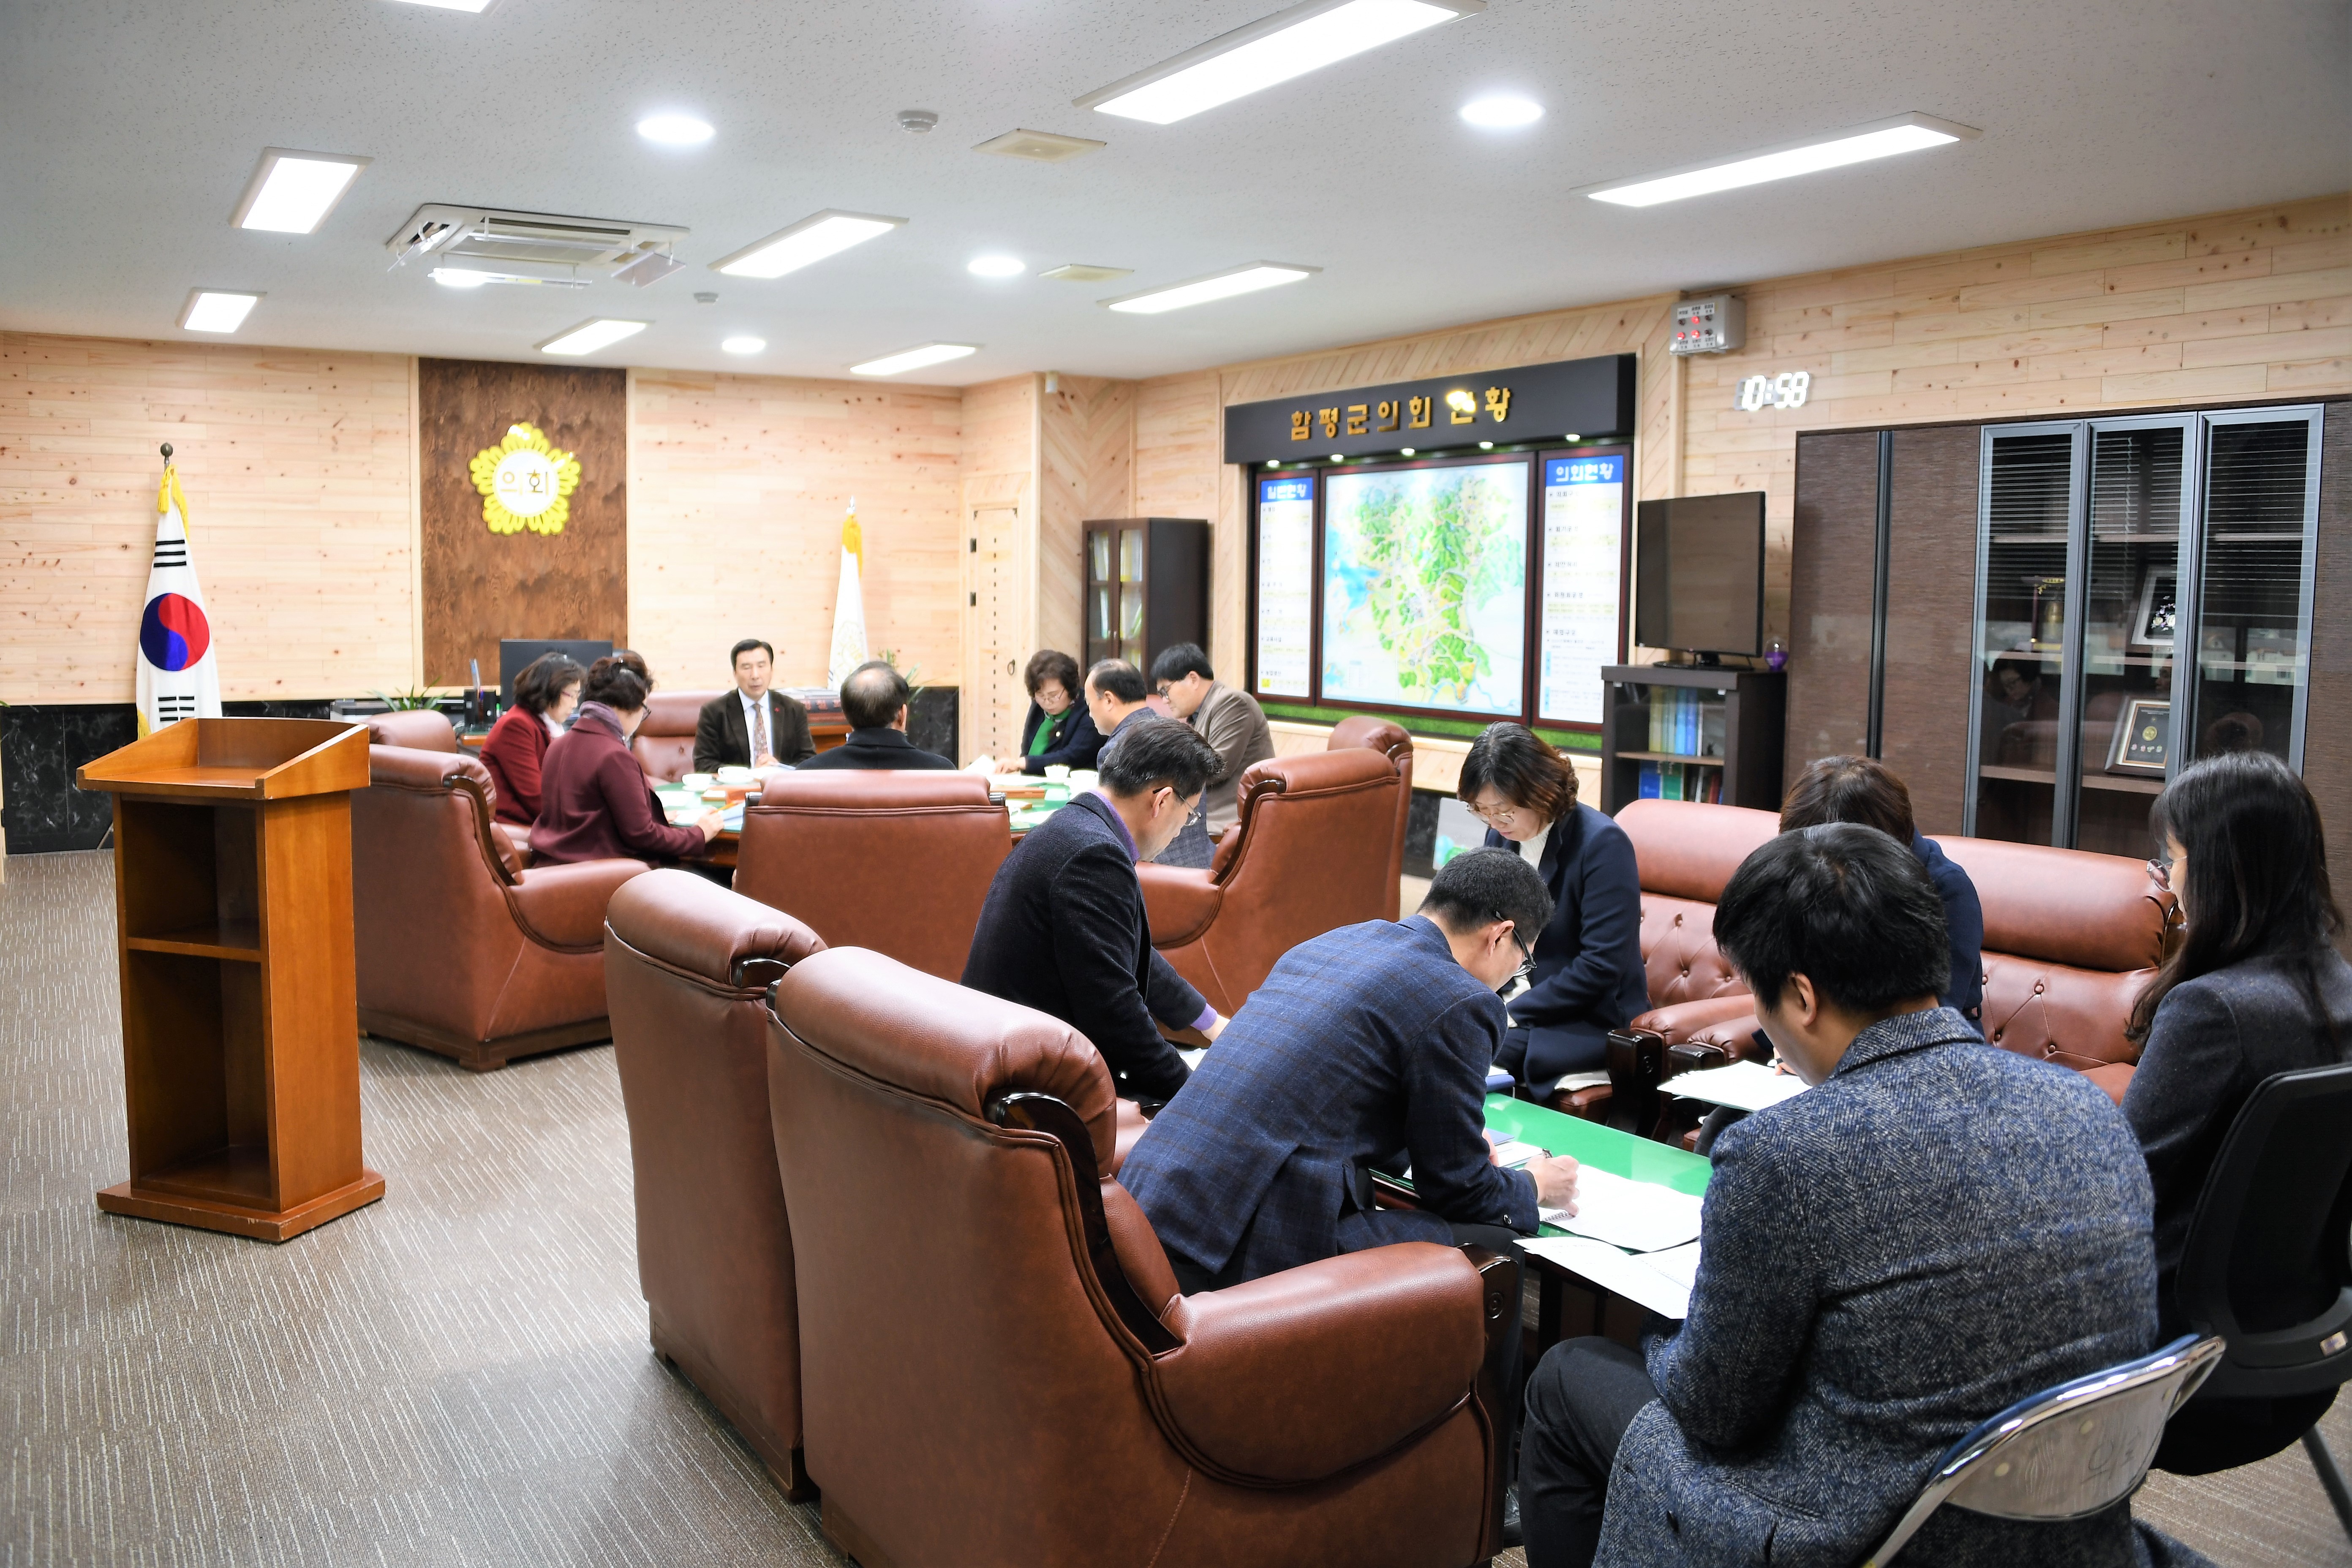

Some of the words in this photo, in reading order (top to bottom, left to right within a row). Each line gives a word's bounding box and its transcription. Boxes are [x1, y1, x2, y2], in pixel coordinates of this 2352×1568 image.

[1291, 395, 1432, 441] 함평군의회
[500, 469, 549, 496] 의회
[1555, 462, 1614, 482] 의회현황
